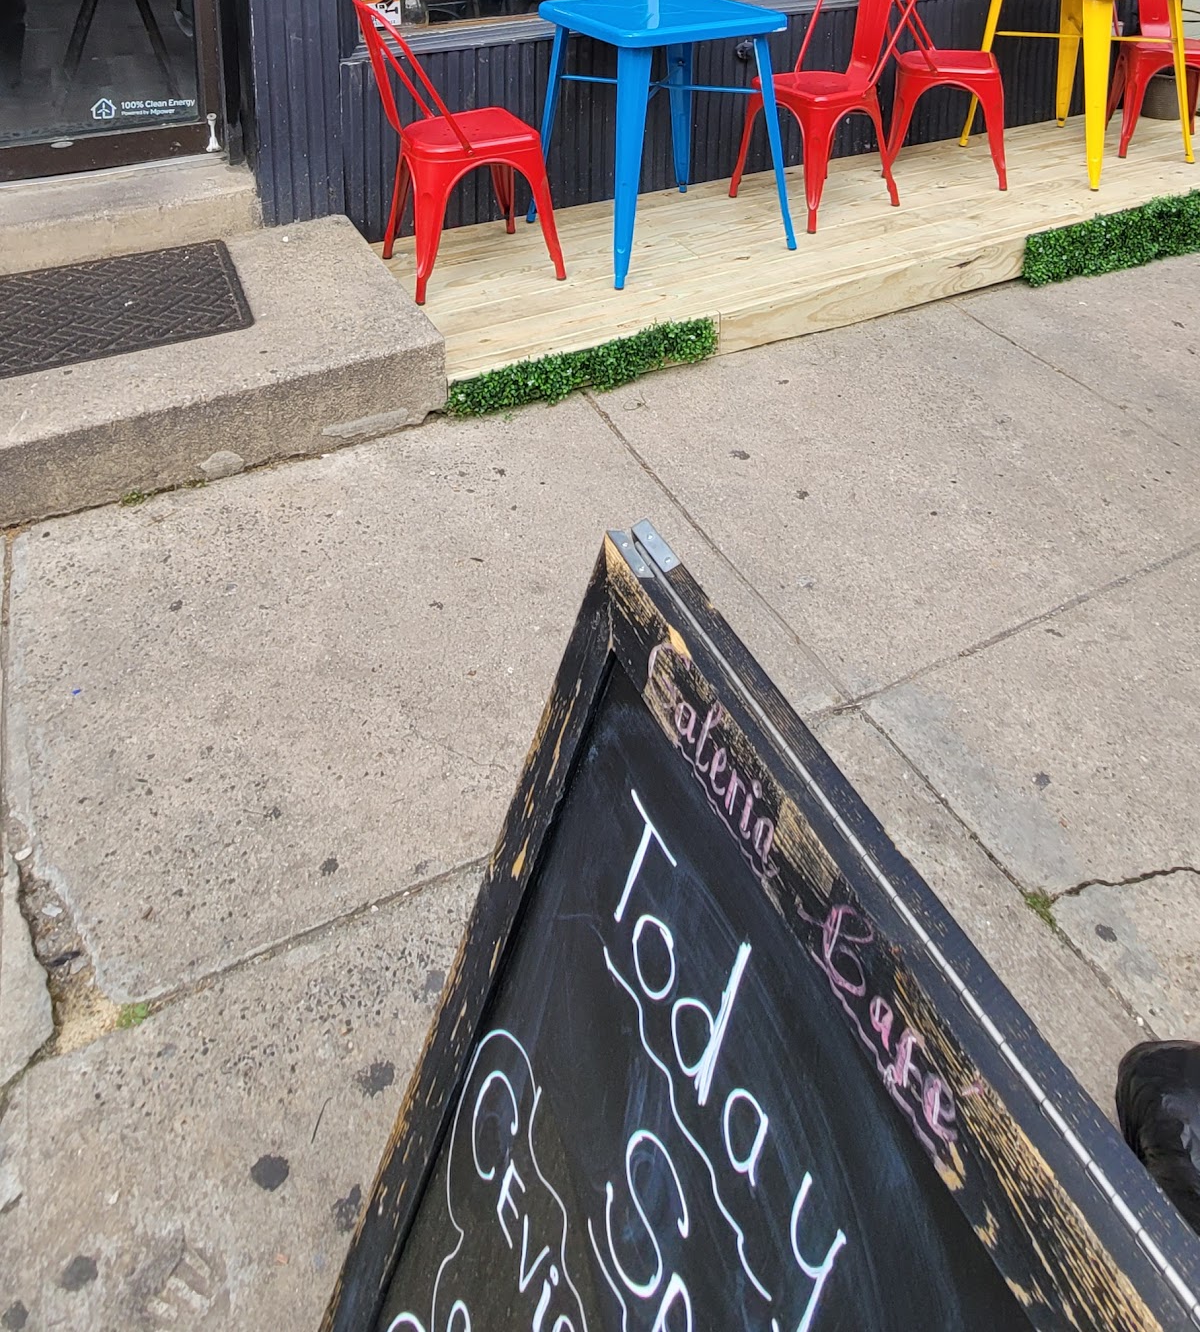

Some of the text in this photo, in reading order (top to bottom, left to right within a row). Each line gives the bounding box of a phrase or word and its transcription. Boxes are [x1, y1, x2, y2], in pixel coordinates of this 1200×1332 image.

[121, 98, 195, 109] 100% Clean Energy
[613, 788, 846, 1332] Today
